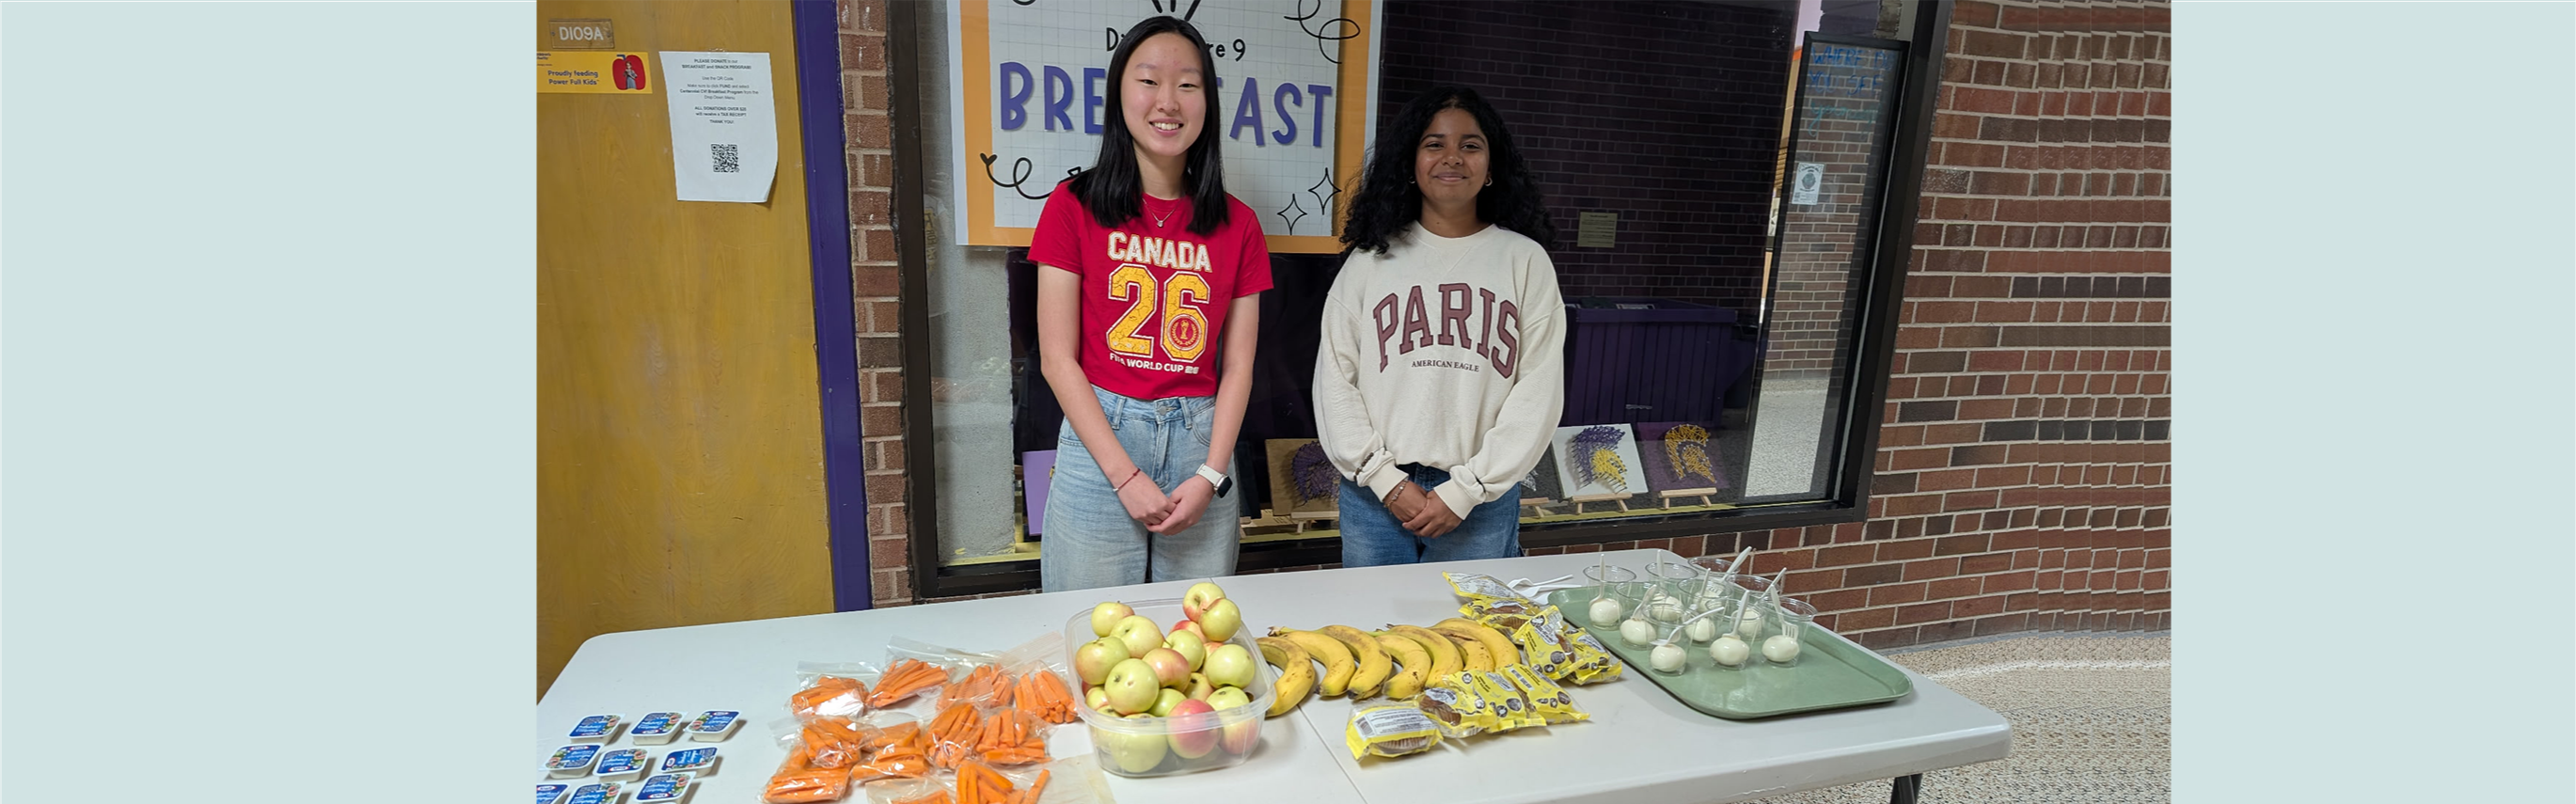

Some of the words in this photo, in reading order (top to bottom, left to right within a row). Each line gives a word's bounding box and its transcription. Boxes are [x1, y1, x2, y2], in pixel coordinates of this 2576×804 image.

[1233, 39, 1246, 62] 9
[1810, 45, 1864, 69] WHERE
[547, 70, 572, 78] Proudly
[574, 70, 598, 78] feeding
[1108, 231, 1212, 273] CANADA
[1106, 262, 1210, 363] 26
[1372, 282, 1520, 380] PARIS
[1127, 358, 1162, 370] WORLD
[1163, 363, 1184, 372] CUP
[1412, 359, 1452, 368] AMERICAN
[1454, 361, 1479, 372] EAGLE
